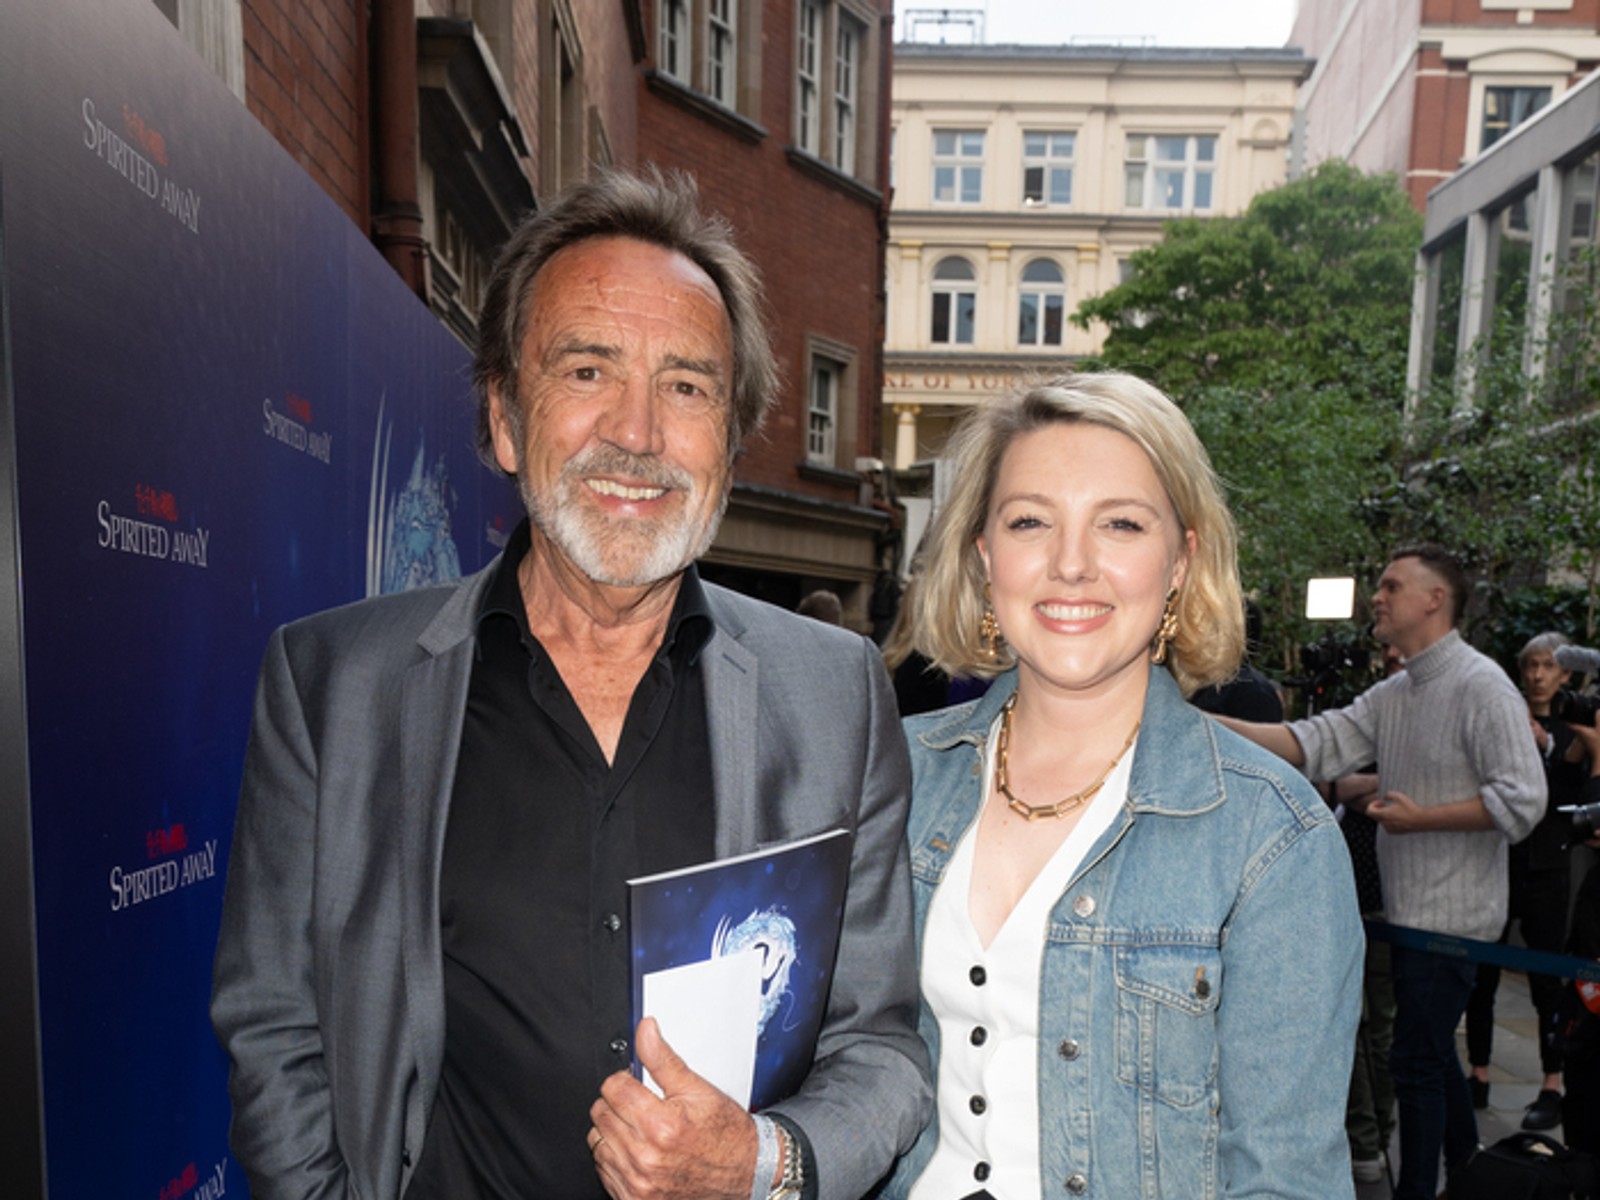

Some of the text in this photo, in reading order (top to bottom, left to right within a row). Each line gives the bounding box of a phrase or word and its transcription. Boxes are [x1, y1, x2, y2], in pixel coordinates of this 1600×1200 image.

[83, 98, 159, 198] SPIRITED
[161, 179, 200, 234] AWAY
[923, 373, 955, 390] OF
[263, 398, 307, 452] SPIRITED
[307, 431, 333, 464] AWAY
[98, 500, 169, 559] SPIRITED
[172, 527, 209, 567] AWAY
[110, 860, 179, 911] SPIRITED
[181, 839, 218, 887] AWAY
